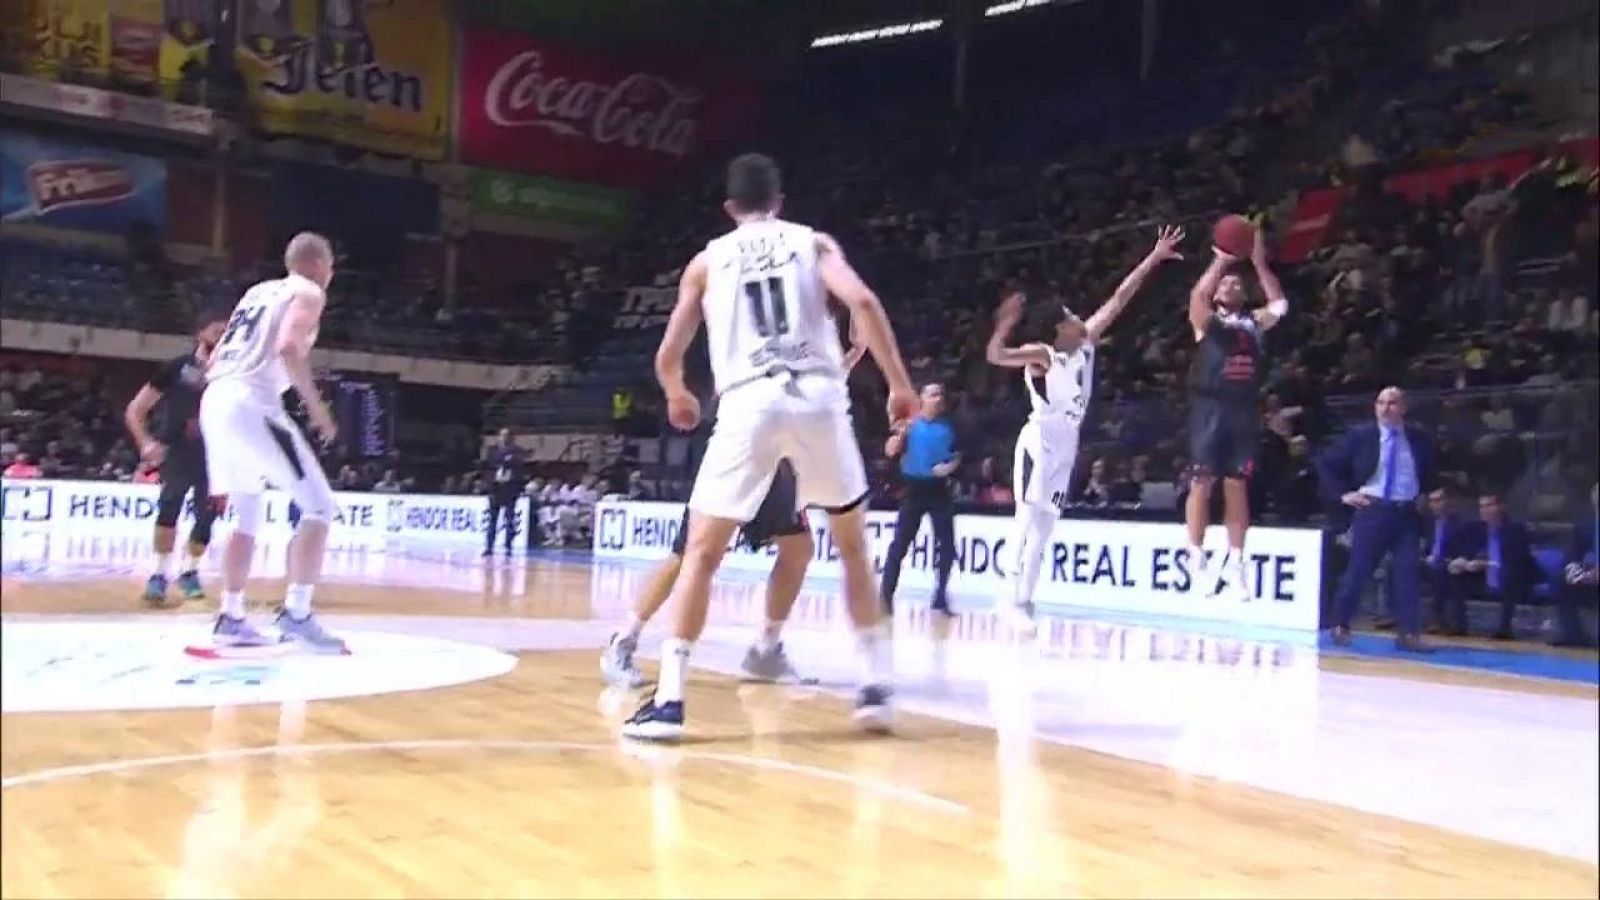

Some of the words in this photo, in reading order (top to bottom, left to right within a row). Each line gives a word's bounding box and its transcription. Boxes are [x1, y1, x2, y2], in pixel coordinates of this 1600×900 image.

[262, 37, 423, 113] Jelen
[745, 275, 789, 337] 11
[1051, 542, 1136, 588] REAL
[1151, 547, 1296, 602] ESTE
